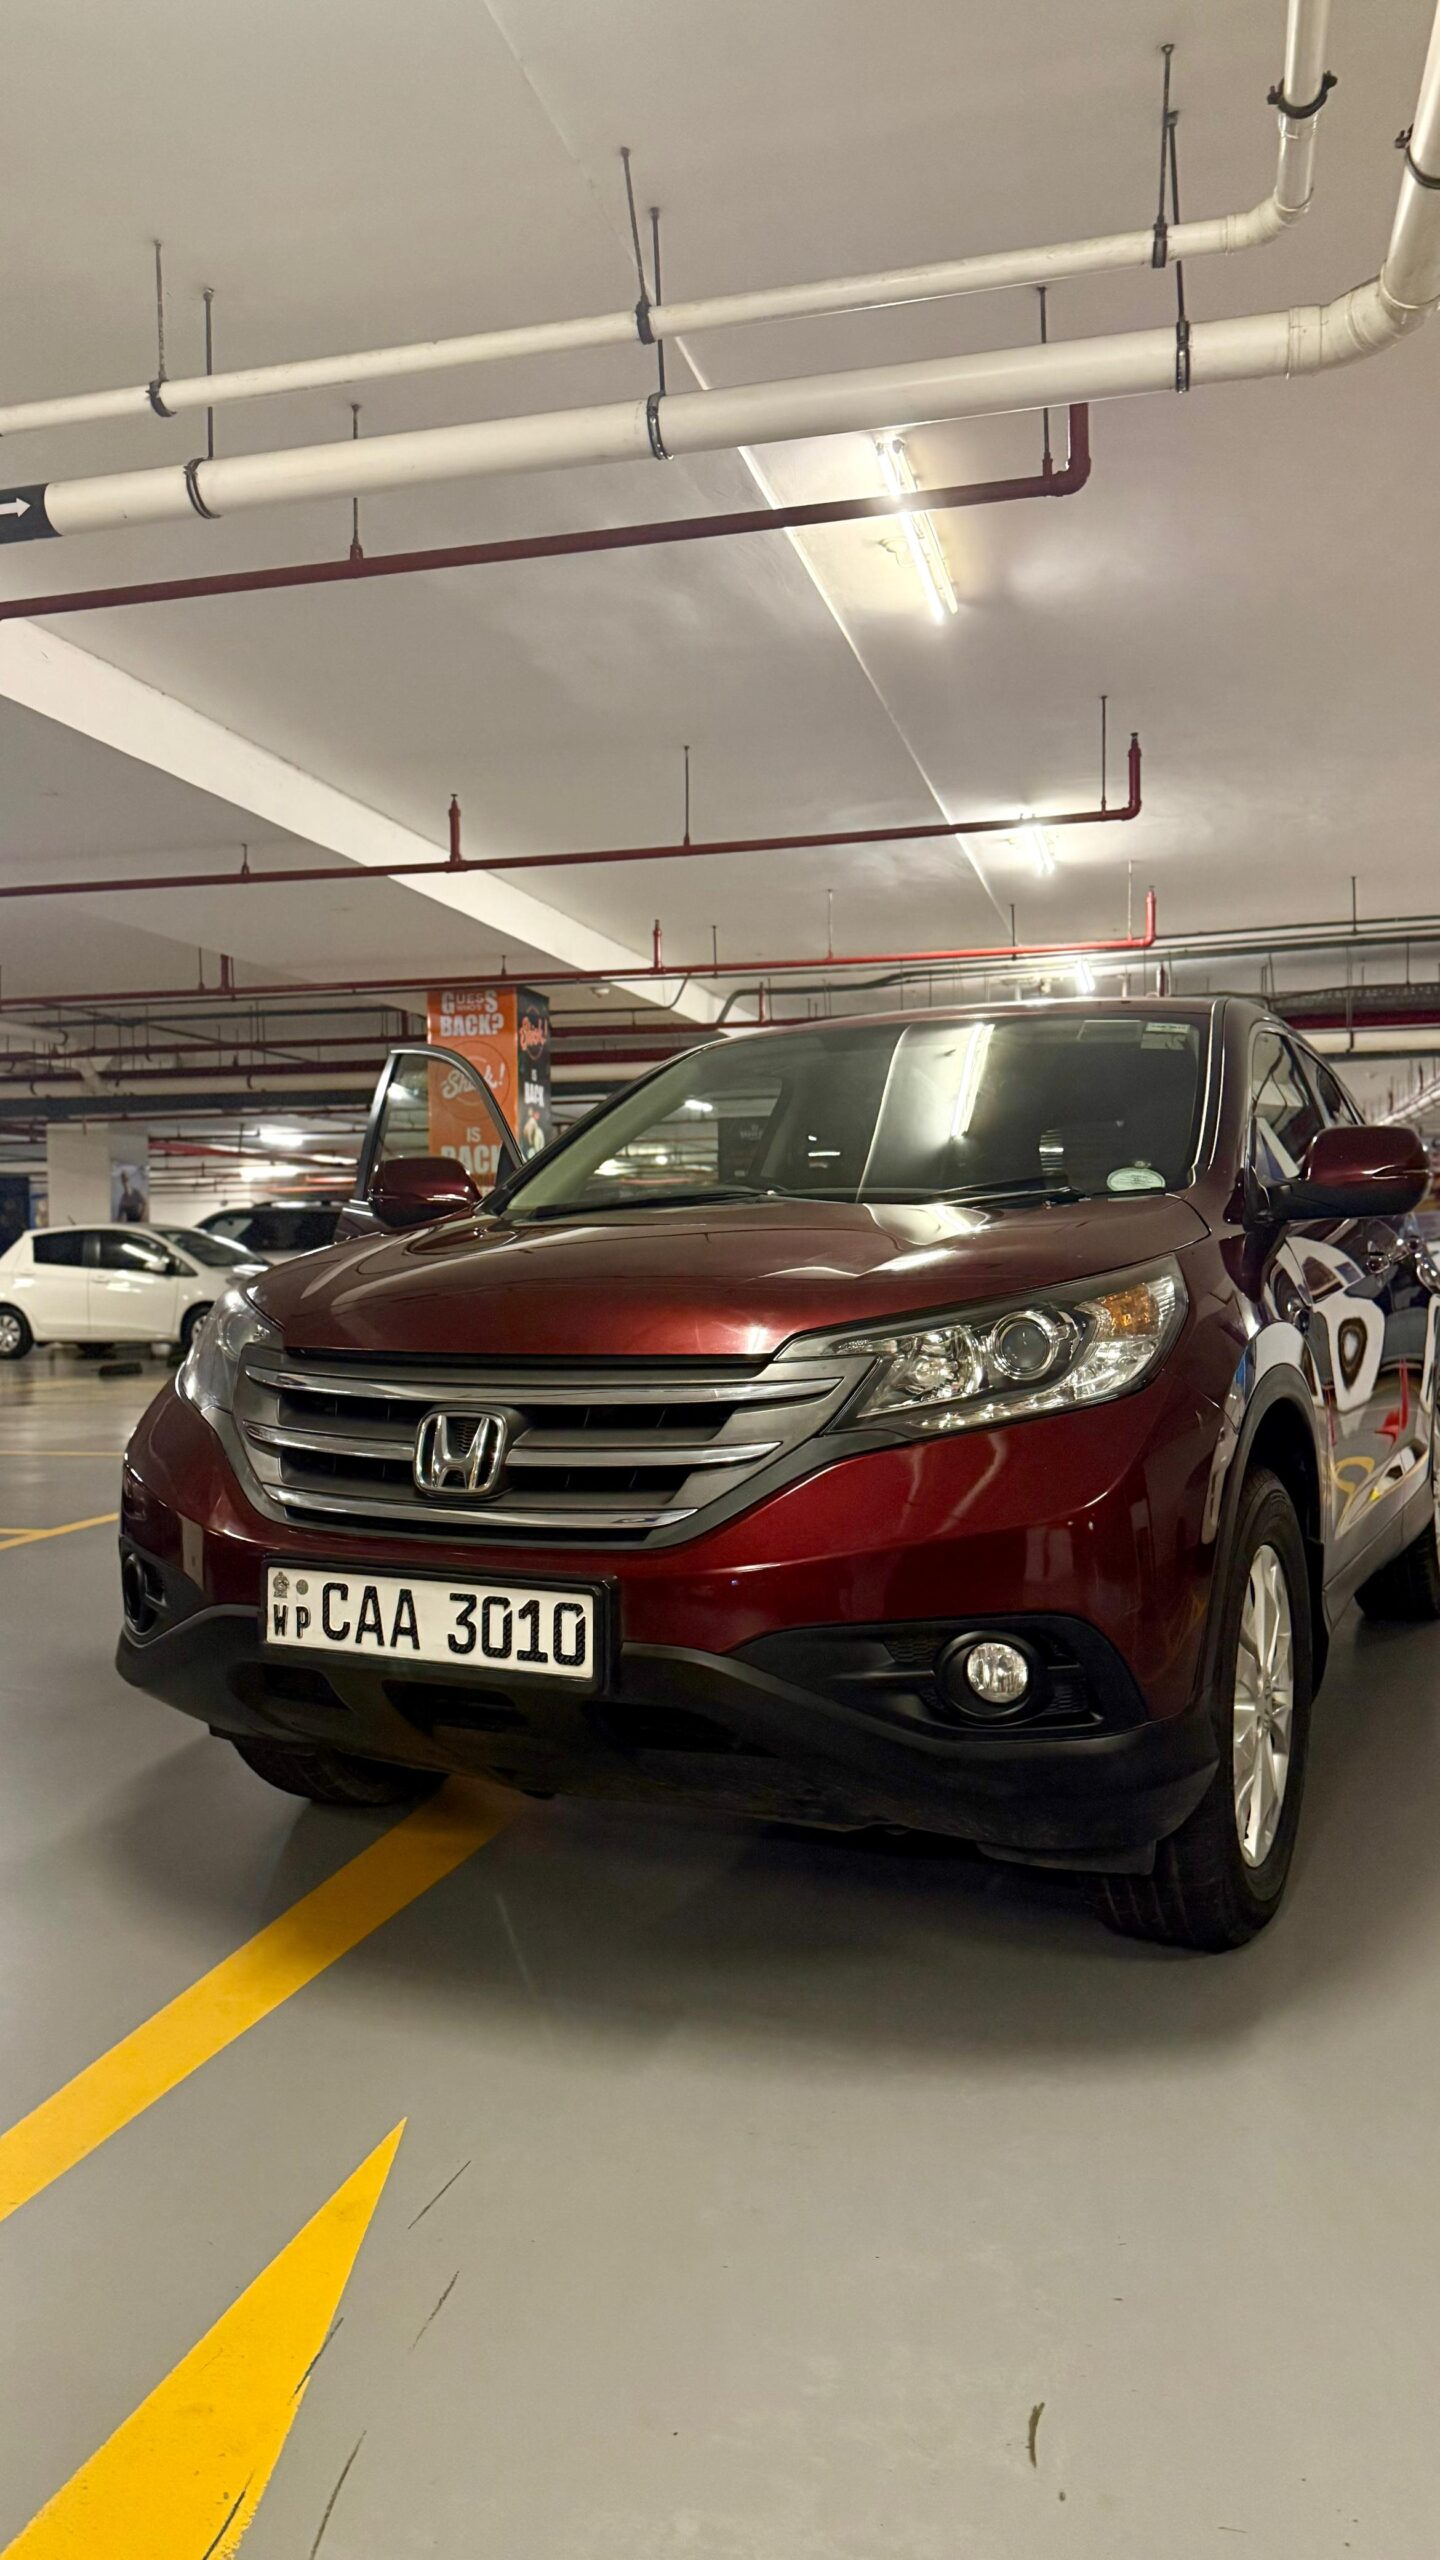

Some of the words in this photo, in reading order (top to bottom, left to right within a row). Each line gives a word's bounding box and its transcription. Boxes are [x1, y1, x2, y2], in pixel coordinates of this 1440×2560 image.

[440, 1013, 504, 1037] BACK?
[466, 1126, 481, 1142] IS
[322, 1582, 420, 1650] CAA
[447, 1592, 587, 1667] 3010
